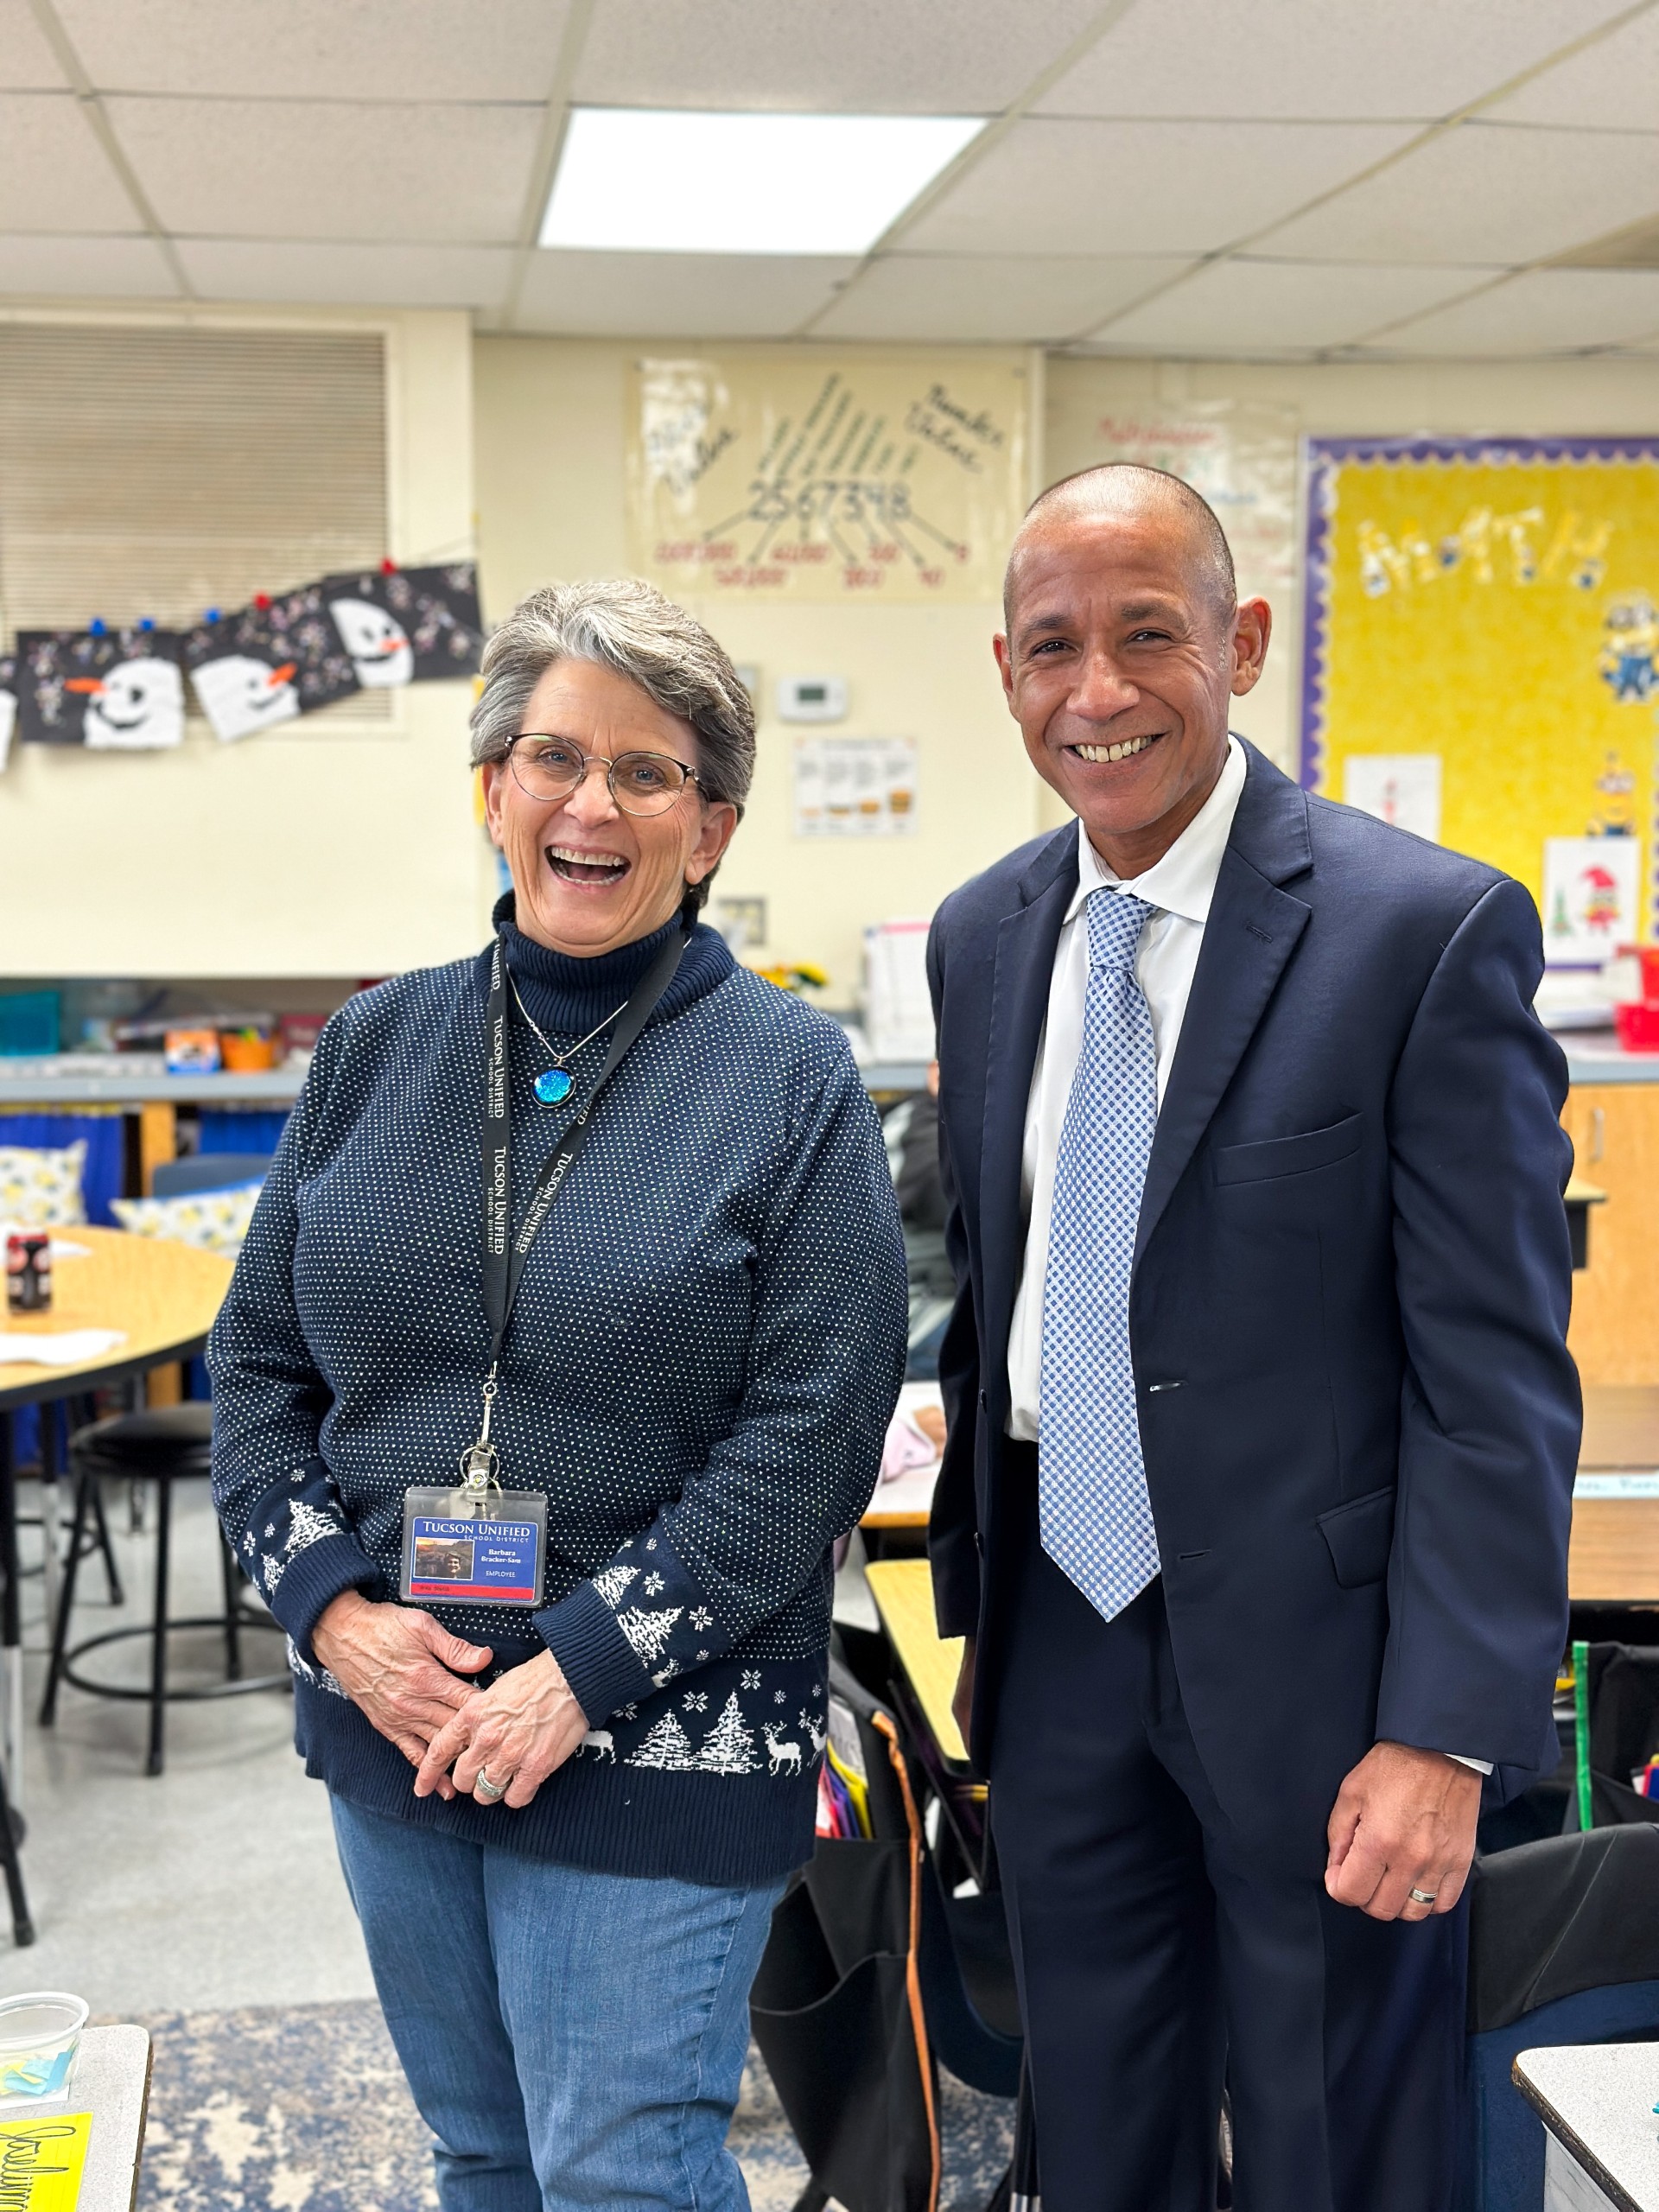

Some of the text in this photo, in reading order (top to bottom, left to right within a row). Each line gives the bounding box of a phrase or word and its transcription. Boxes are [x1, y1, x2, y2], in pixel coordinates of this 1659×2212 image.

[493, 1015, 505, 1119] TUCSON UNIFIED
[494, 1146, 507, 1255] TUCSON UNIFIED
[515, 1186, 544, 1251] SCHOOL DISTRICT
[519, 1153, 574, 1254] TUCSON UNIFIED
[423, 1521, 531, 1537] TUCSON UNIFIED
